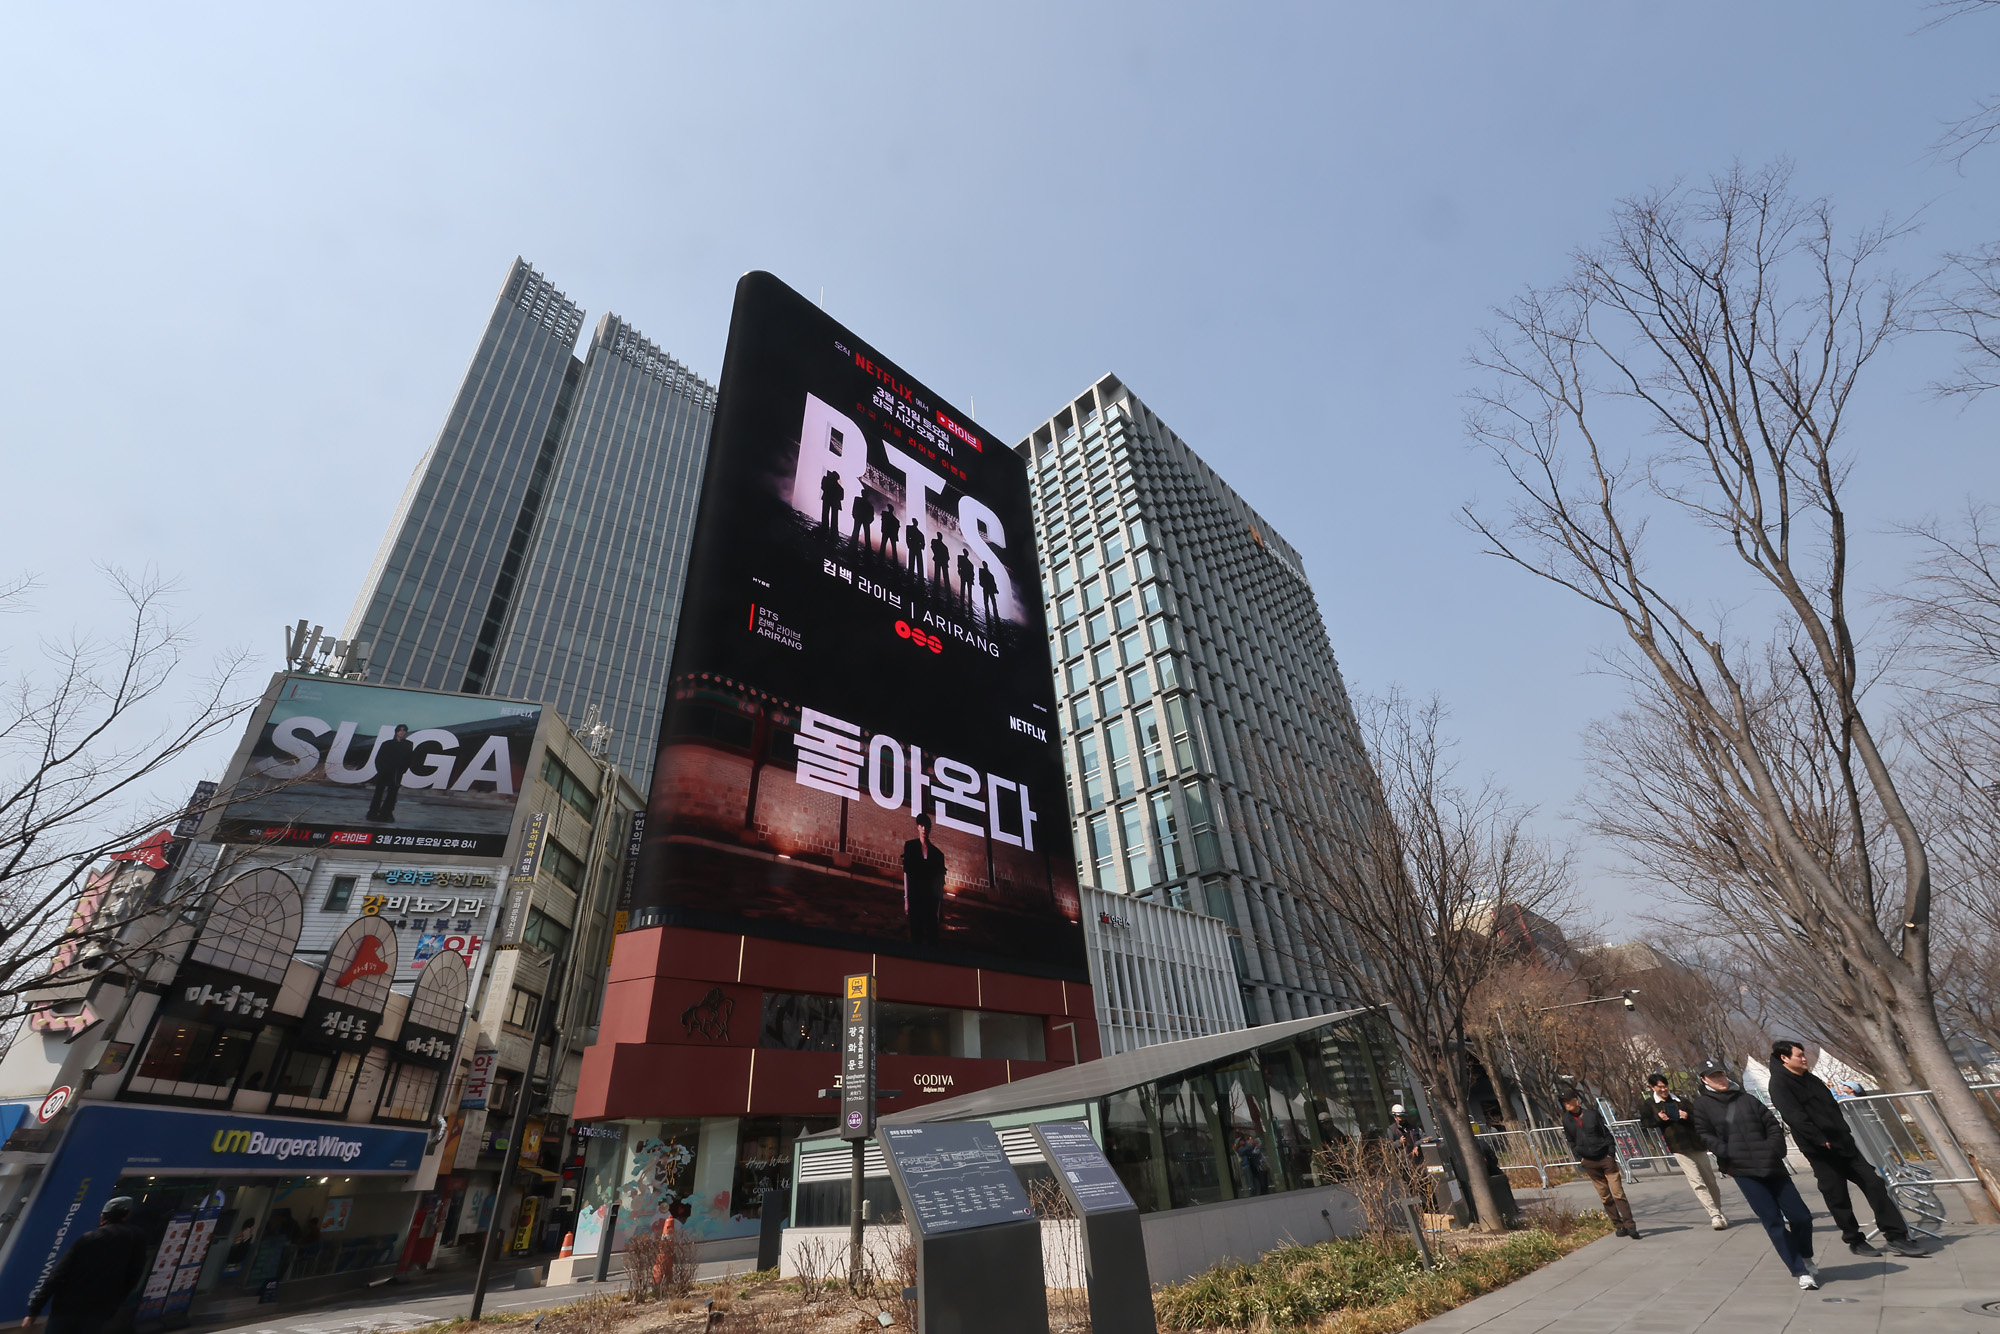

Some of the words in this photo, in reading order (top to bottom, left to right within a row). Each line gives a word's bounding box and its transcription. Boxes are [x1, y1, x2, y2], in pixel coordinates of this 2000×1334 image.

[855, 352, 913, 404] NETFLIX
[915, 398, 929, 412] 에서
[947, 420, 977, 448] 라이브
[876, 386, 895, 405] 3월
[897, 401, 921, 424] 21일
[922, 417, 950, 443] 토요일
[872, 393, 893, 415] 한국
[895, 410, 915, 429] 시간
[916, 425, 935, 443] 오후
[937, 439, 954, 457] 8시
[791, 392, 1013, 620] BTS
[752, 576, 770, 588] HYBE
[759, 607, 779, 621] BTS
[823, 558, 852, 584] 컴백
[858, 576, 901, 610] 라이브
[923, 610, 1000, 658] ARIRANG
[757, 626, 803, 650] ARIRANG
[758, 616, 775, 631] 컴백
[776, 624, 801, 641] 라이브
[501, 706, 534, 719] NETFLIX
[1009, 715, 1048, 744] NETFLIX
[255, 715, 514, 795] SUGA
[793, 706, 1038, 852] 돌아온다
[263, 826, 313, 841] NETFLIX
[340, 832, 369, 845] 라이브
[376, 834, 395, 846] 3월
[395, 835, 414, 846] 21일
[415, 836, 441, 848] 토요일
[441, 837, 459, 849] 오후
[460, 838, 477, 849] 8시
[520, 812, 544, 873] 강비뇨의학과의원
[361, 894, 486, 918] 강비뇨기과
[410, 917, 472, 934] 피부과
[185, 985, 268, 1019] 마녀김밥
[853, 1000, 861, 1013] 7
[321, 1011, 367, 1041] 청담동
[847, 1026, 857, 1071] 광화문
[468, 1056, 492, 1097] 약국
[913, 1074, 954, 1086] GODIVA
[45, 1095, 64, 1114] 30
